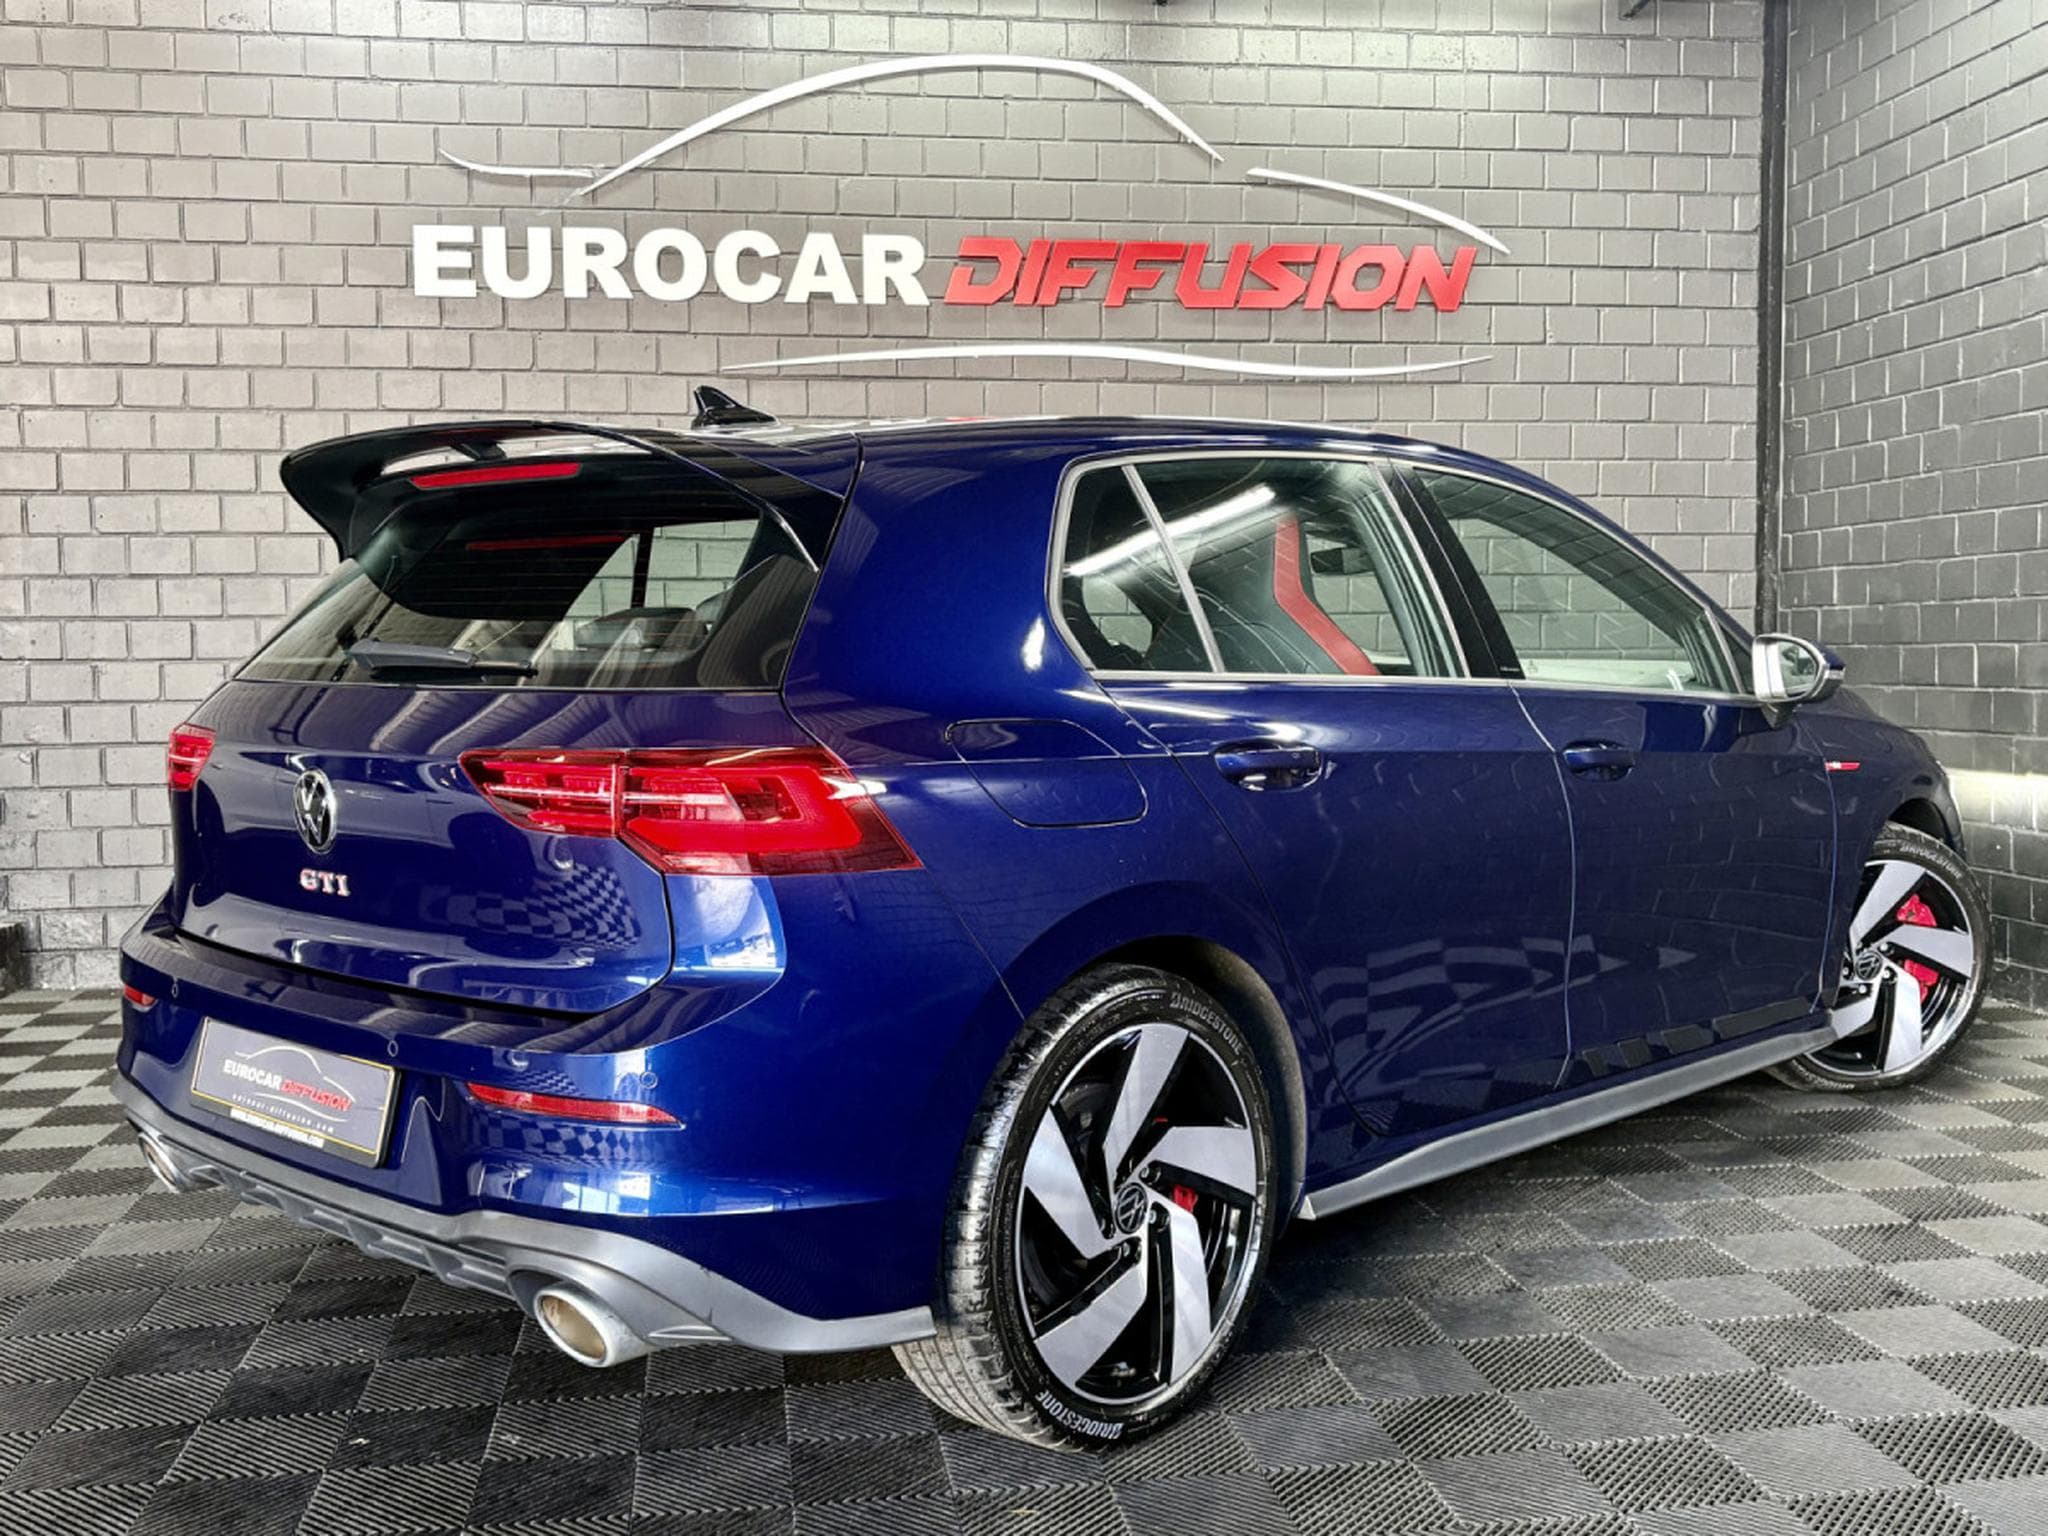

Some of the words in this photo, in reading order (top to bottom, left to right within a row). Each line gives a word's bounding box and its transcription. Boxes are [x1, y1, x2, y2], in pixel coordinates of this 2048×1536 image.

[412, 224, 930, 307] EUROCAR
[944, 236, 1478, 312] DIFFUSION
[299, 867, 350, 897] GTI
[1169, 991, 1244, 1056] BRIDGESTONE
[222, 1058, 283, 1092] EUROCAR
[280, 1078, 353, 1113] DIFFUSION
[1034, 1389, 1124, 1440] BRIDGESTONE
